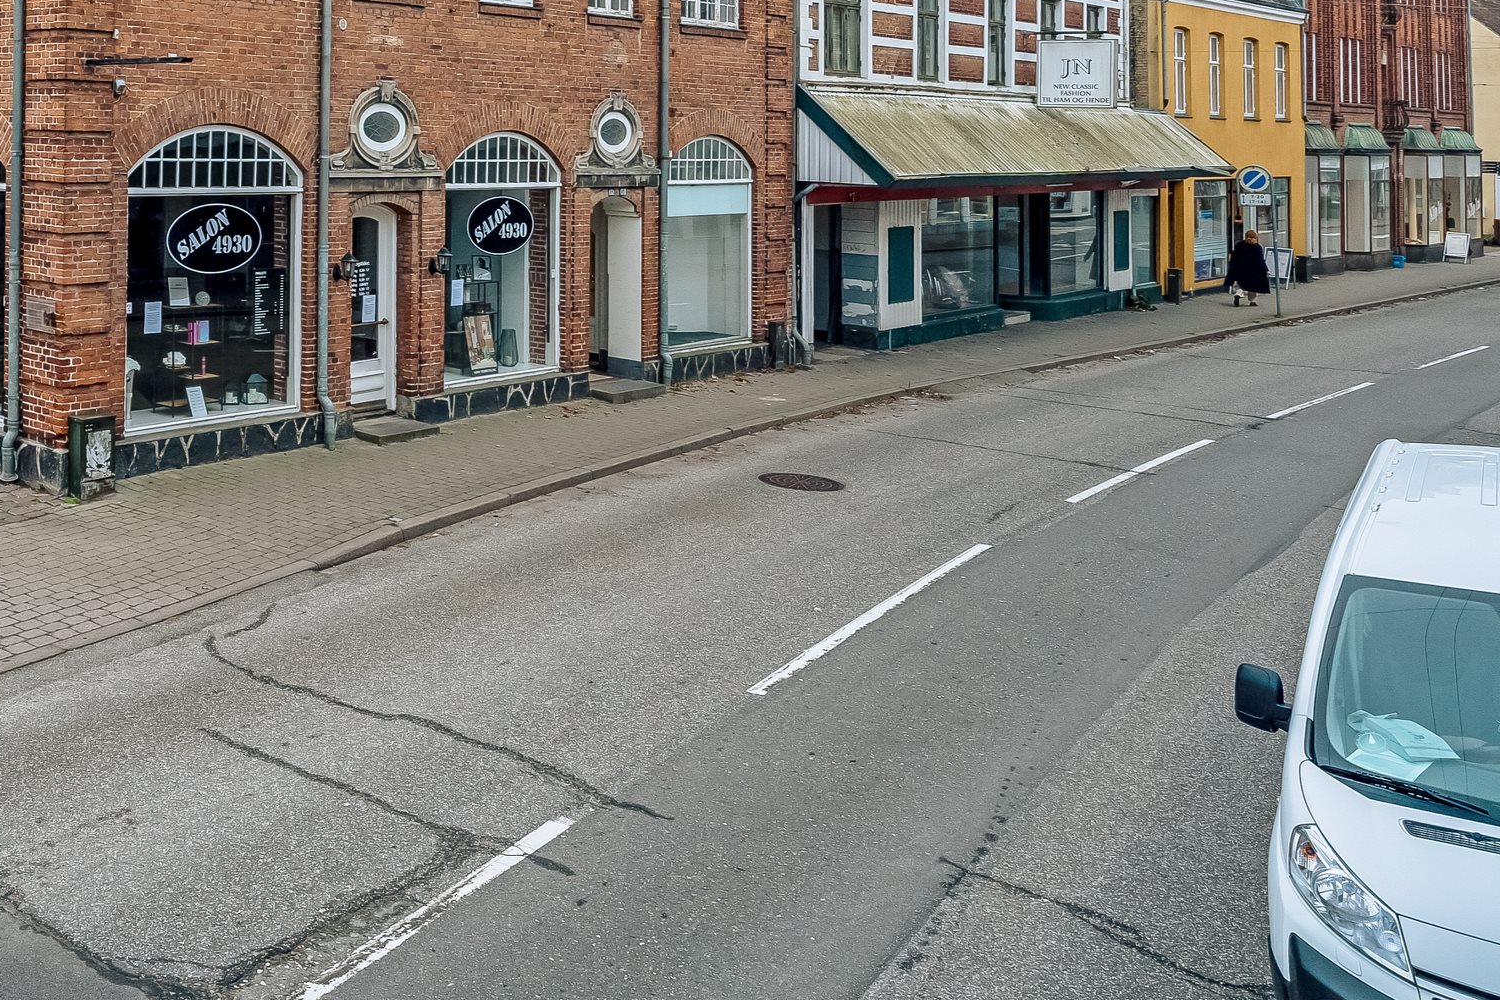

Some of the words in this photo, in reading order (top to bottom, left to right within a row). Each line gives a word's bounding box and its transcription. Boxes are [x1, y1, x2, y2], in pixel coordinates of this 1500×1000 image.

[1060, 58, 1092, 79] JN
[474, 200, 511, 244] SALON
[498, 222, 528, 239] 4930
[176, 208, 230, 260] SALON
[211, 234, 252, 254] 4930
